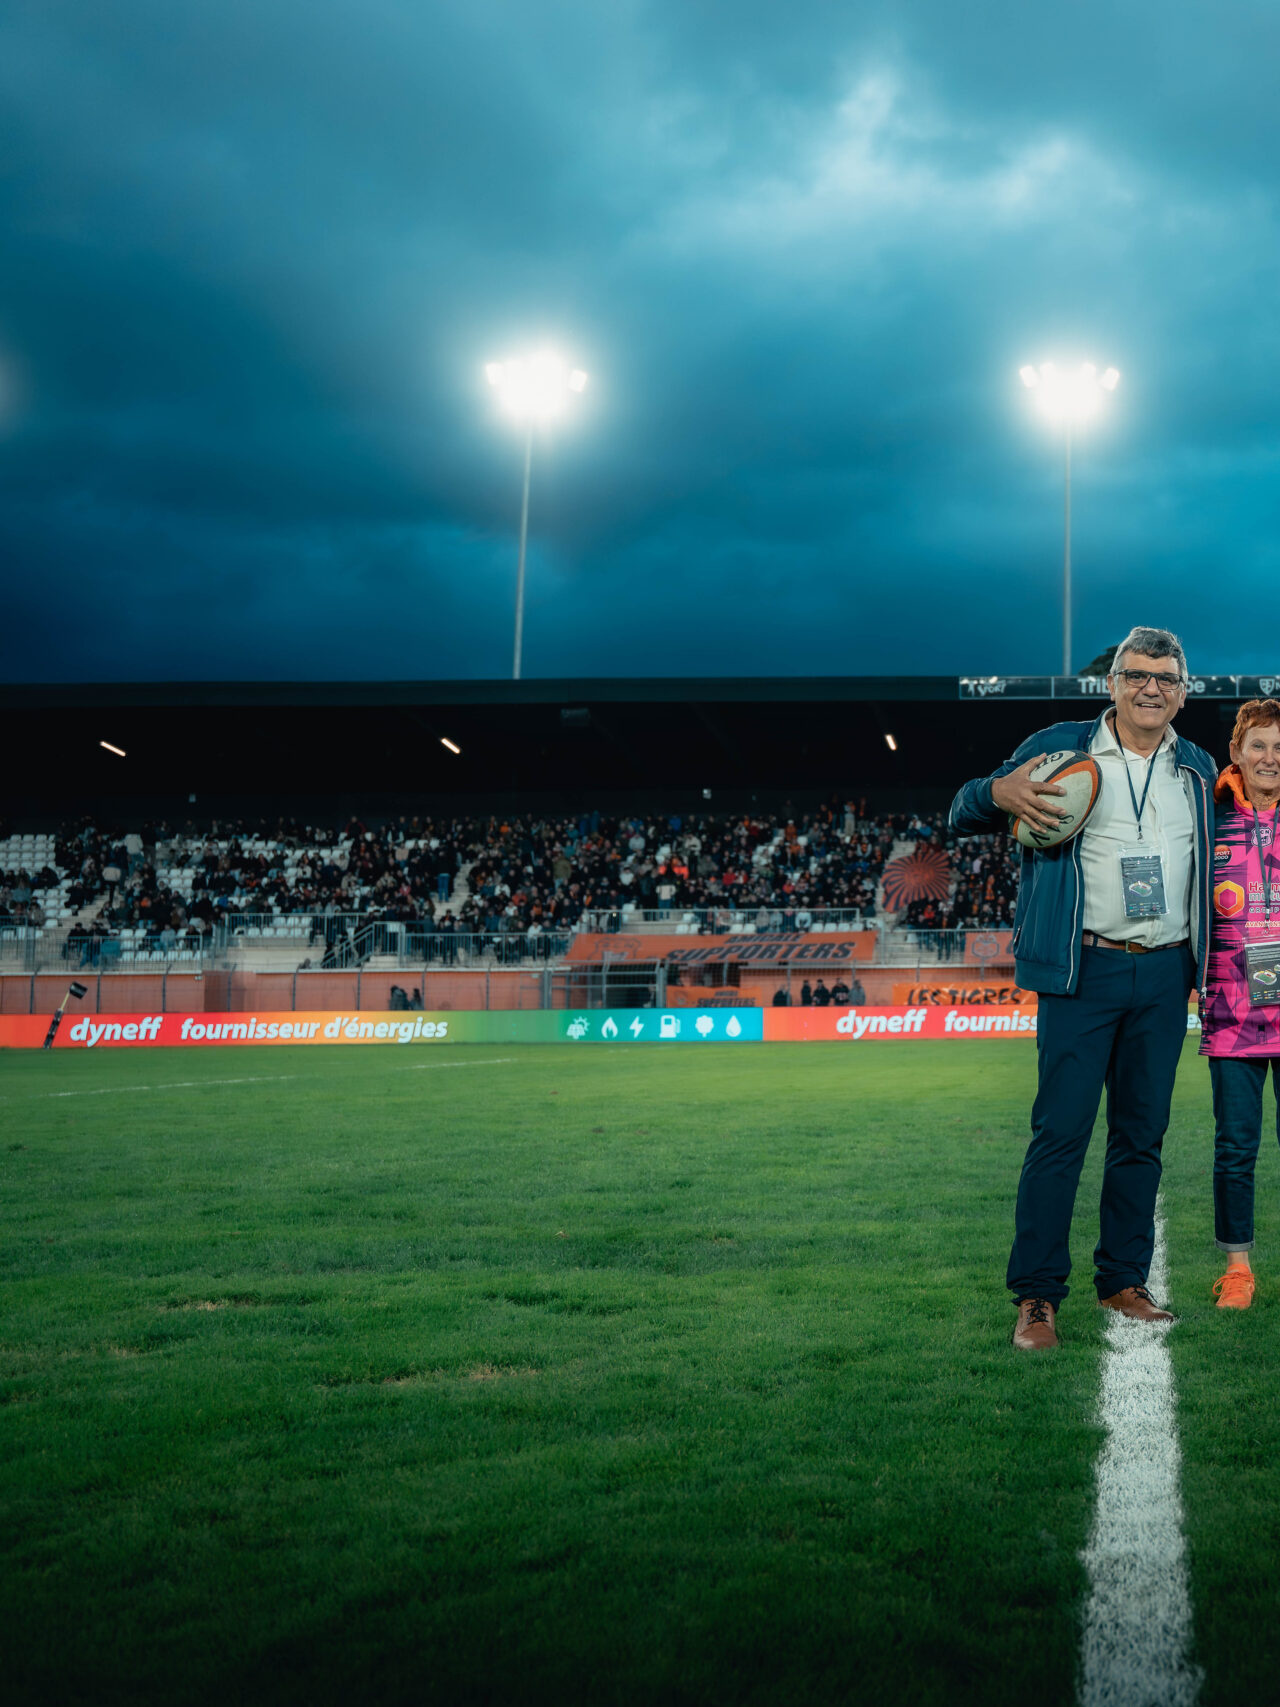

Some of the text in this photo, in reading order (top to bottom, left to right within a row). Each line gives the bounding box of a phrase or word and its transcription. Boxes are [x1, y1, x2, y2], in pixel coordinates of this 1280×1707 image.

[1077, 677, 1111, 695] Trib
[667, 941, 855, 961] SUPPORTERS
[949, 988, 1021, 1006] TIGRES
[70, 1016, 448, 1047] dyneff fournisseur d'énergies
[836, 1009, 1038, 1040] dyneff fourniss
